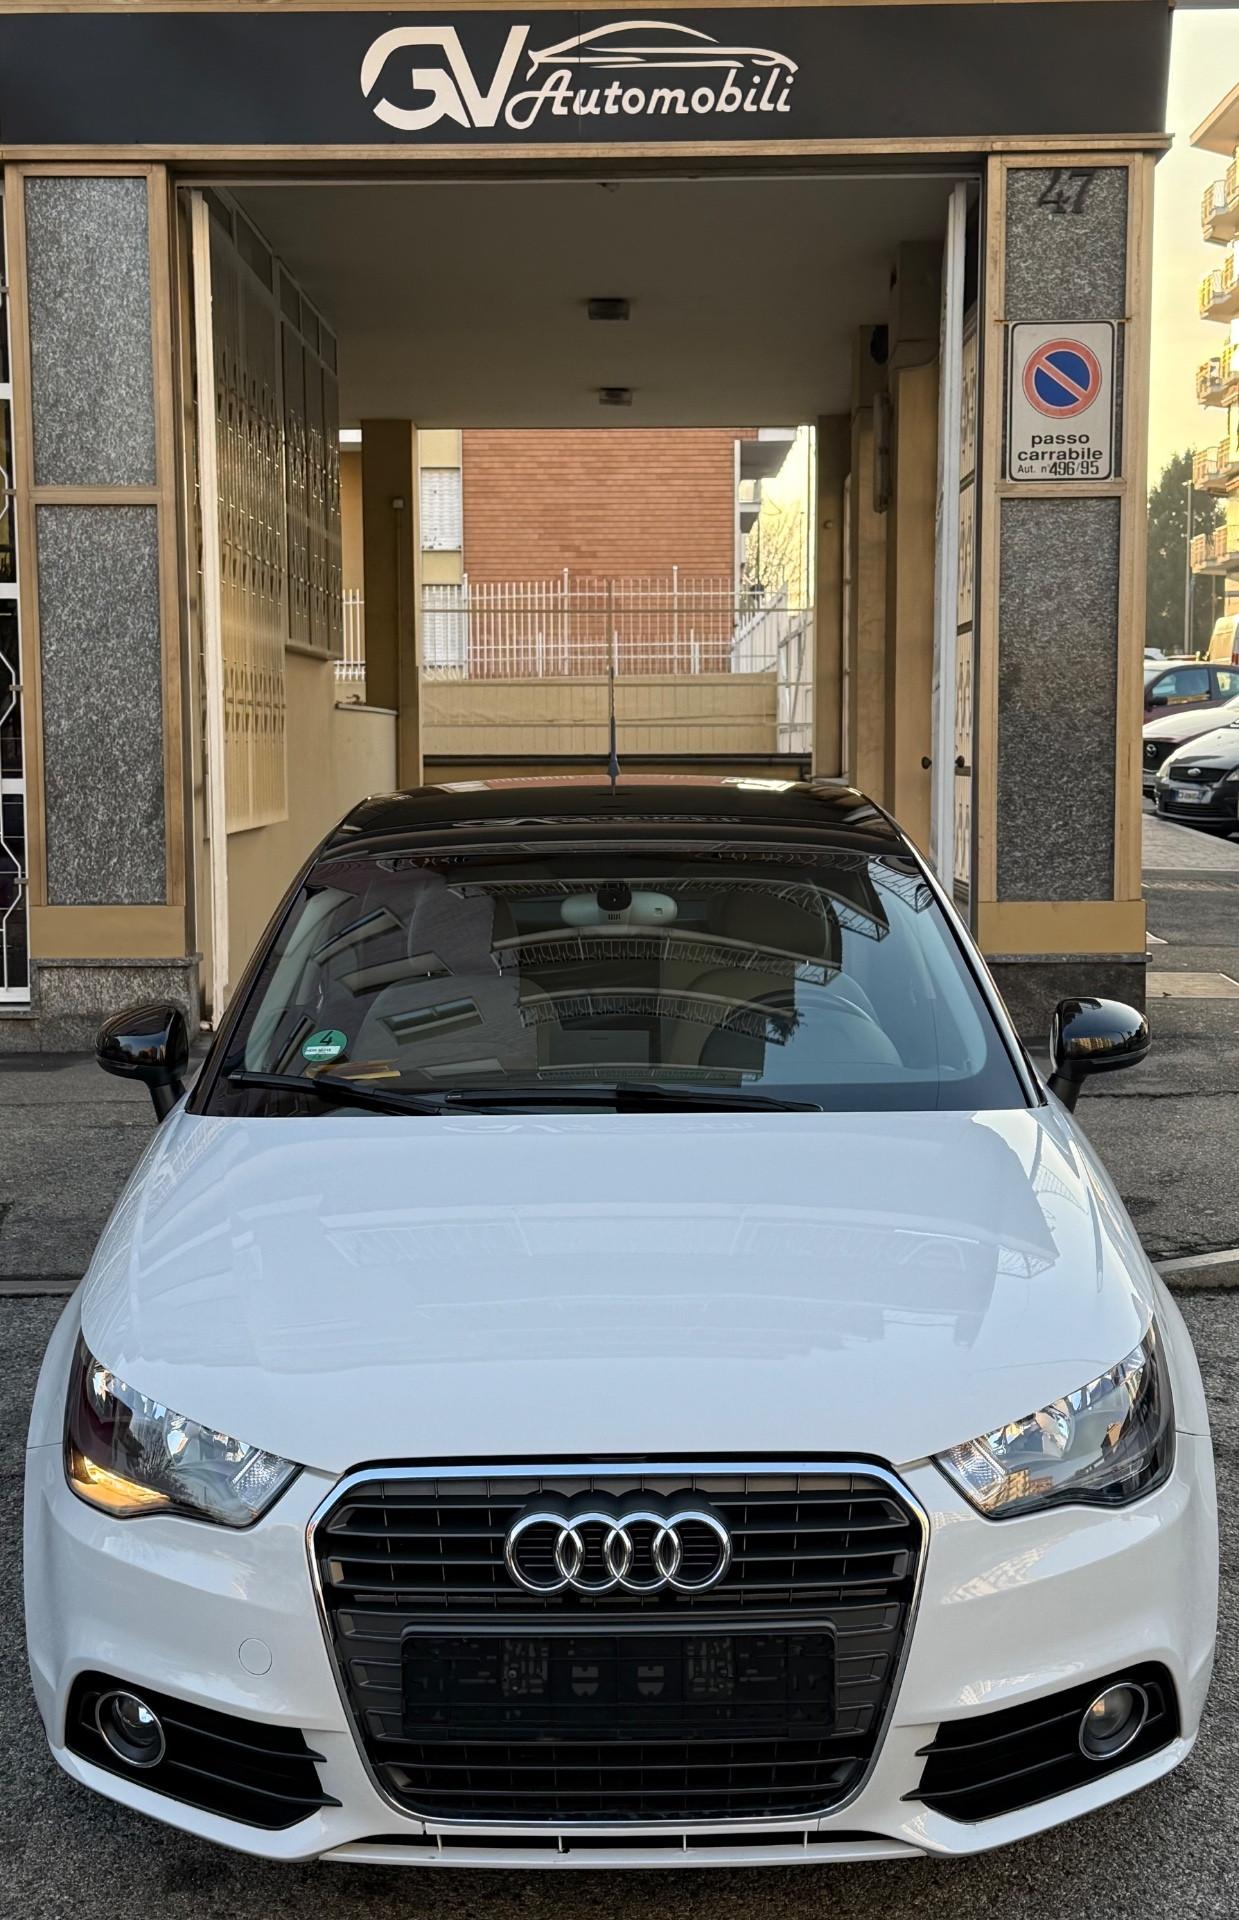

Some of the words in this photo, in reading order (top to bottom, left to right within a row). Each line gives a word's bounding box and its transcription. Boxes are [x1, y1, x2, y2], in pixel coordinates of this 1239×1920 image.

[360, 25, 531, 131] GV
[504, 67, 794, 130] Automobili
[1037, 168, 1097, 214] 47
[1031, 434, 1090, 448] passo
[1017, 447, 1103, 461] carrabile
[1017, 464, 1036, 473] Aut.
[319, 1030, 333, 1045] 4
